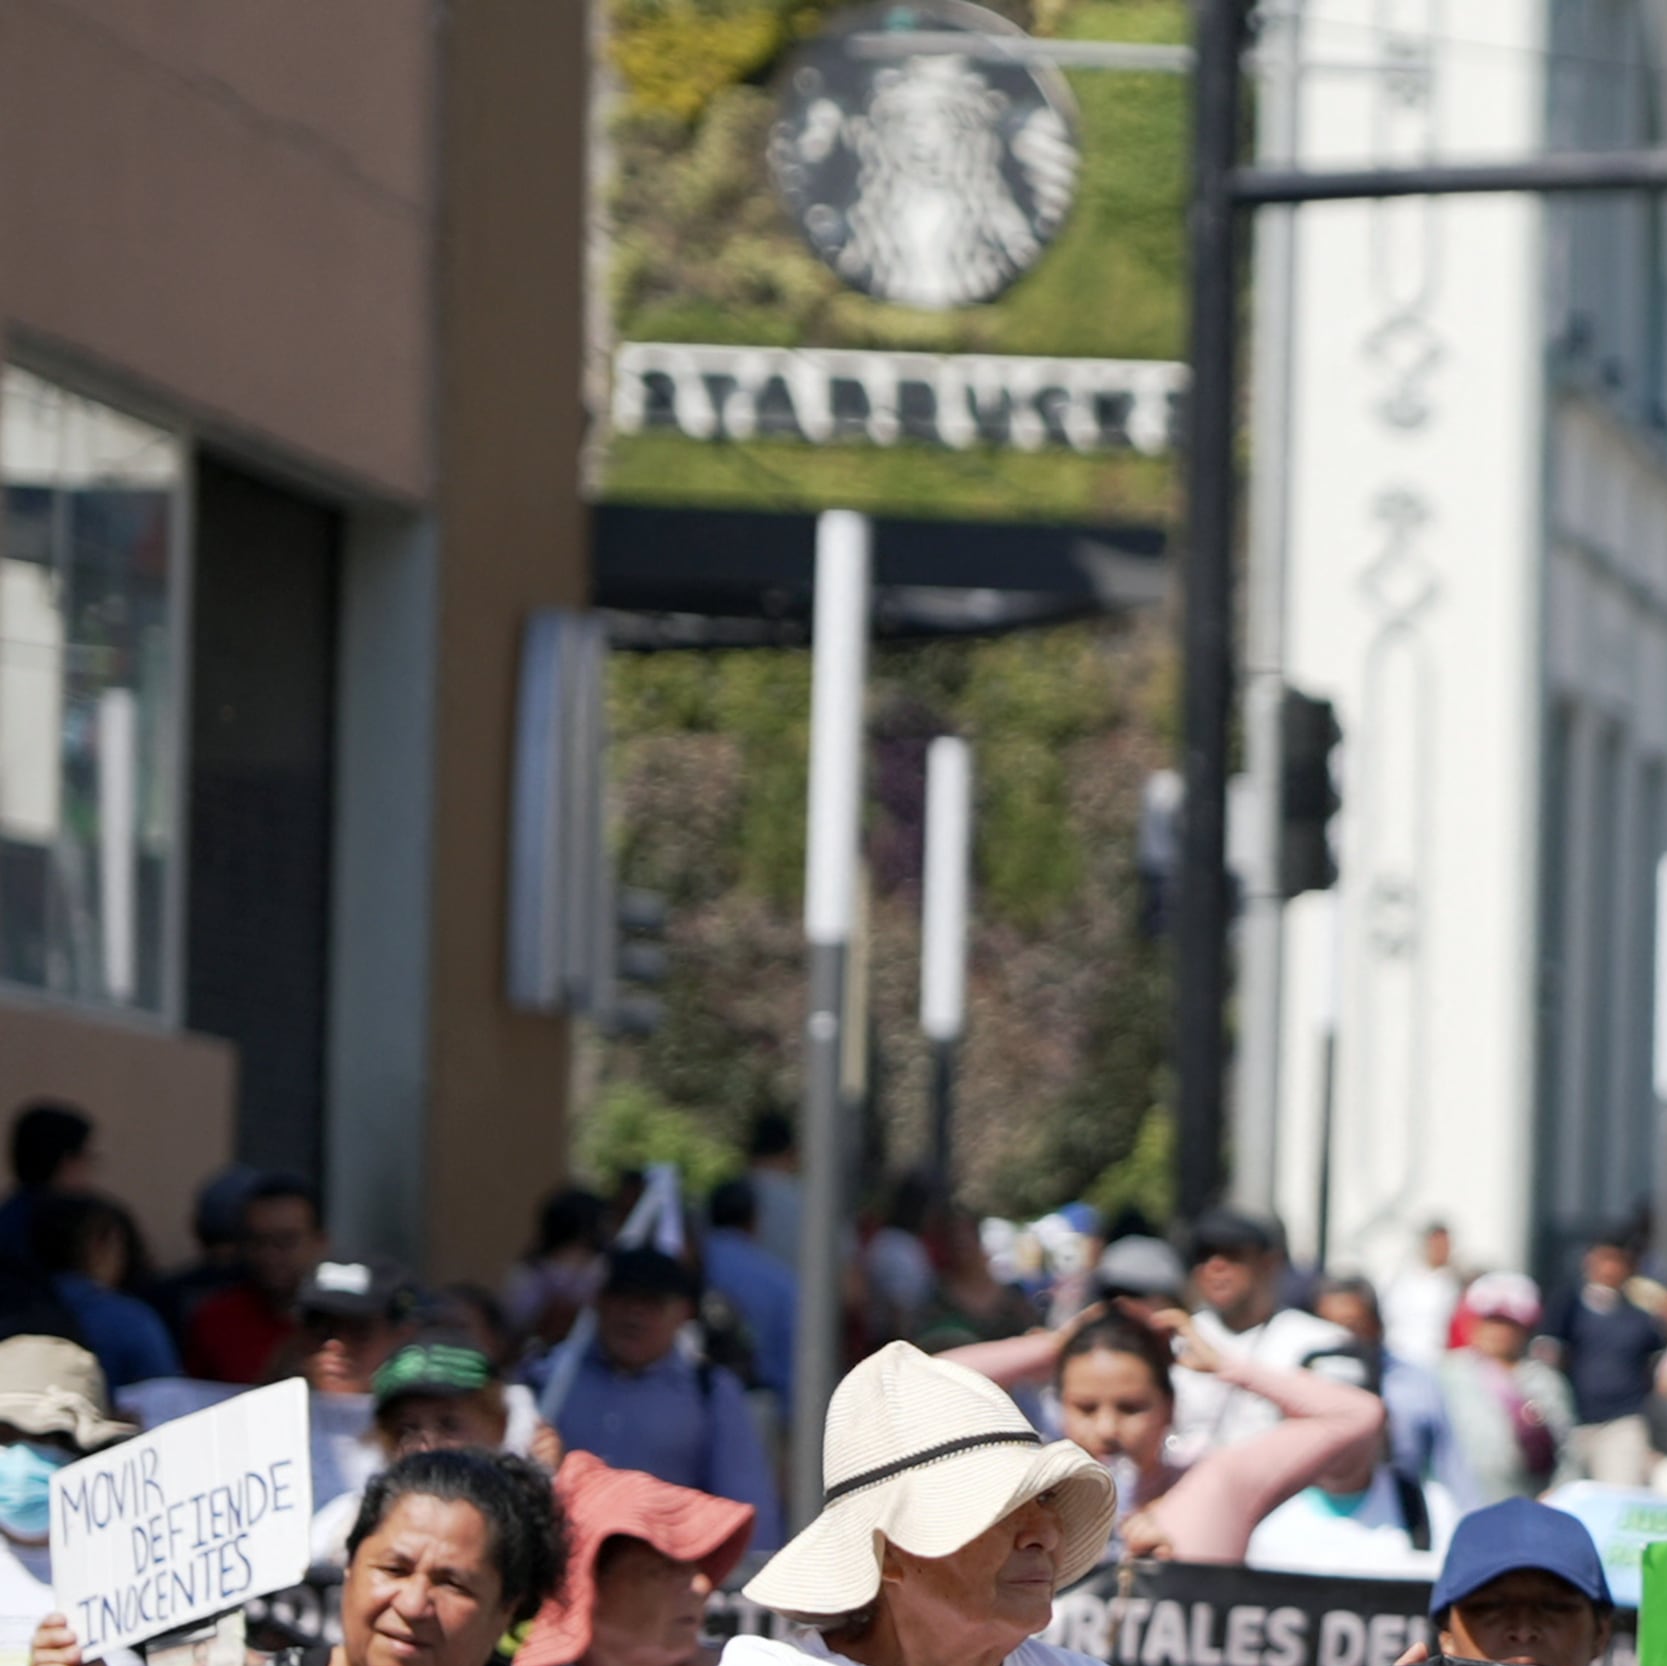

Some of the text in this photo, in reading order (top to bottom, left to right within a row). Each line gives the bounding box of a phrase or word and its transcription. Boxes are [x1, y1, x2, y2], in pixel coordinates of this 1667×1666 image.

[60, 1447, 165, 1548] MOVIR
[131, 1459, 294, 1576] DEFIENDE
[77, 1532, 253, 1649] INOCENTES
